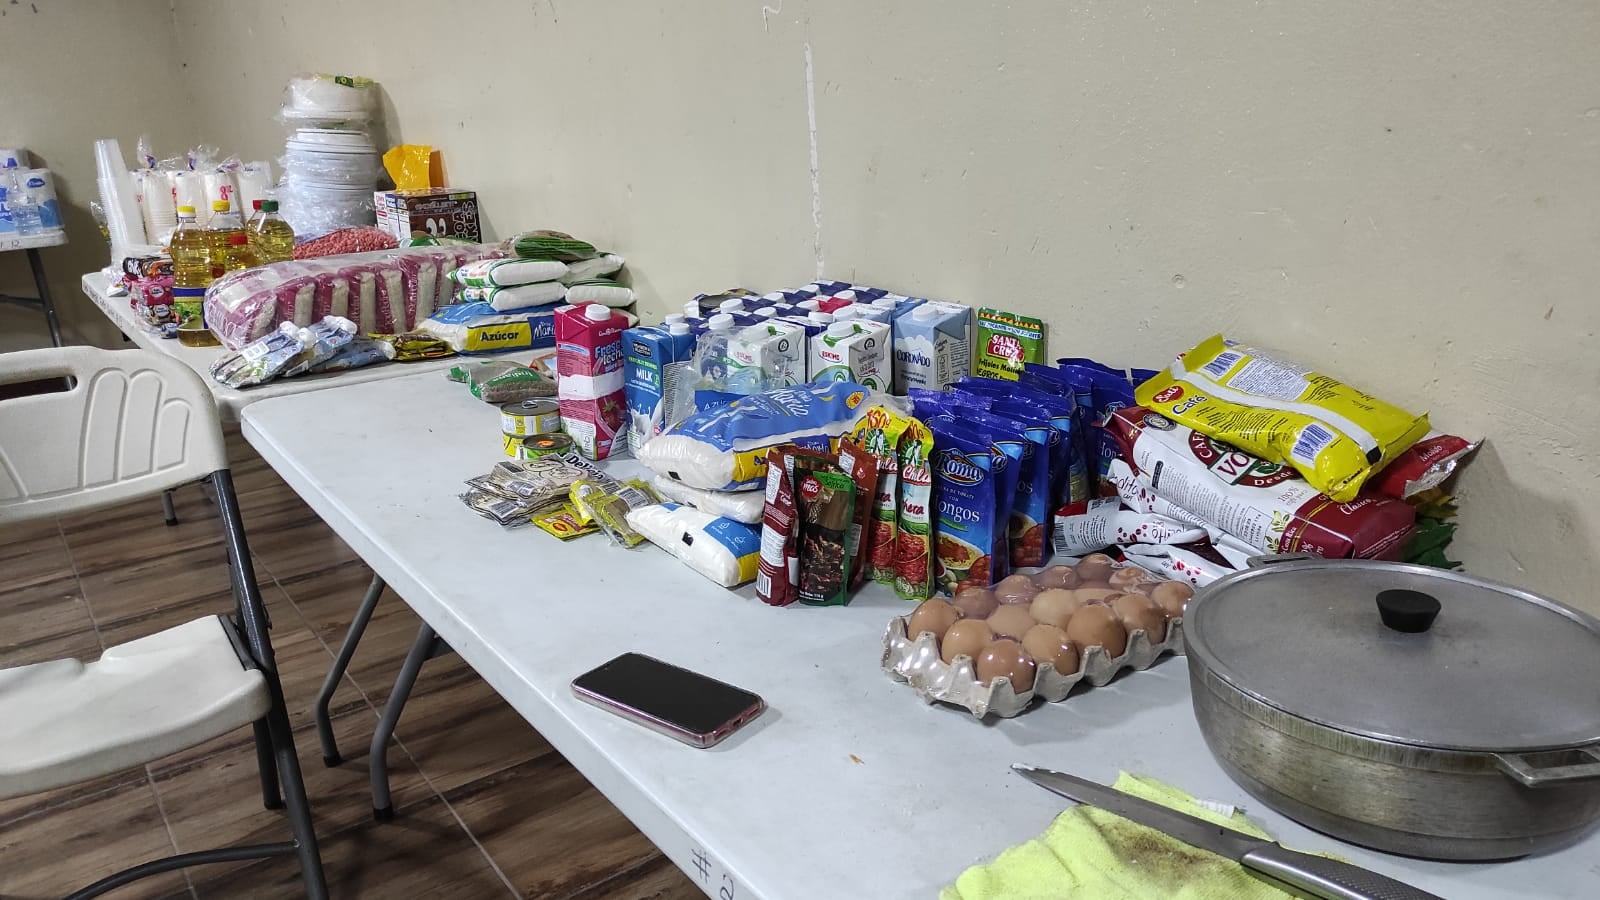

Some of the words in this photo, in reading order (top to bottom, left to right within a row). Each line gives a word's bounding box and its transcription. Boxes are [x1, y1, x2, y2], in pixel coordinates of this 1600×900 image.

[480, 331, 519, 342] Azúcar
[533, 322, 556, 339] Marí
[992, 334, 1020, 349] SANTA
[897, 349, 931, 367] CORONADO
[635, 367, 653, 382] MILK
[1172, 394, 1207, 415] Café
[1217, 453, 1250, 476] VO
